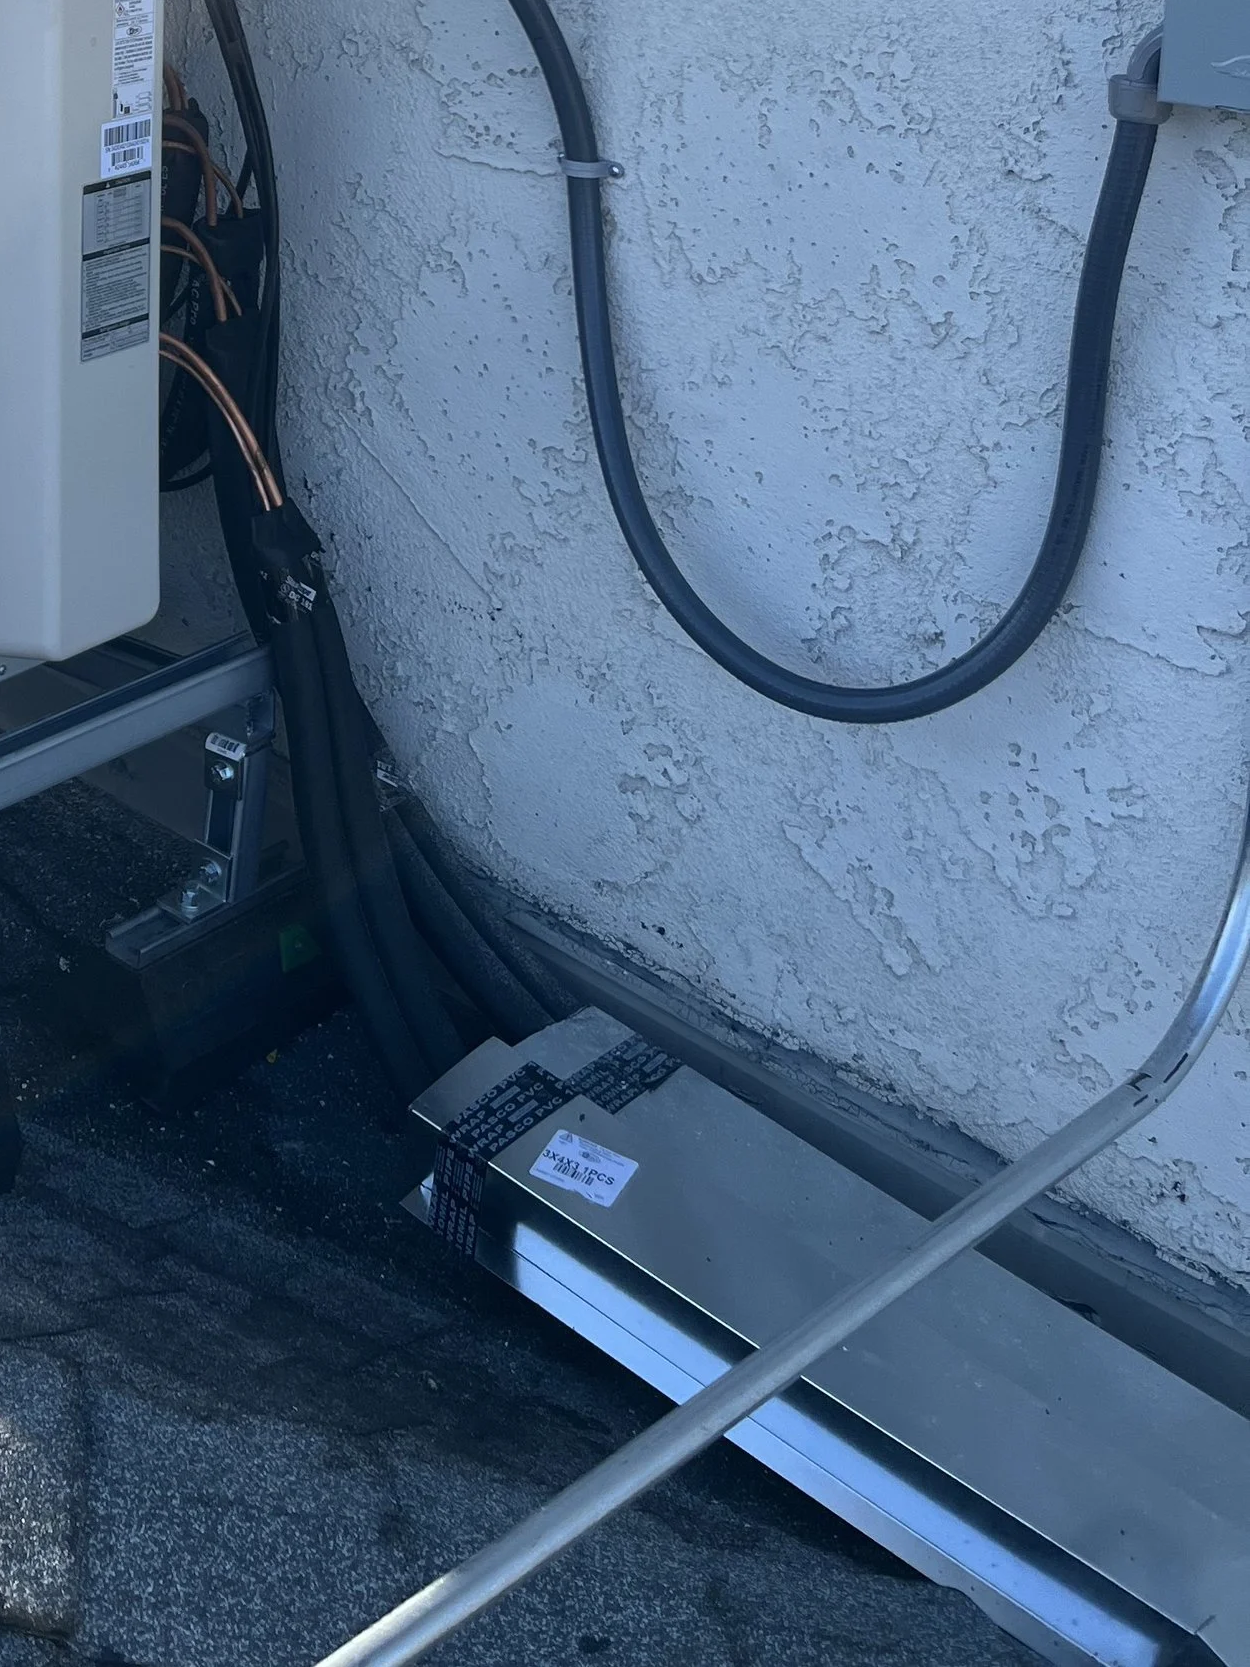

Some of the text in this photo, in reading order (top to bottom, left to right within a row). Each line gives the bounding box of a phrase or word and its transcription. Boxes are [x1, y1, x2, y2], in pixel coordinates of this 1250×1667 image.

[189, 300, 199, 326] Pro
[453, 1068, 526, 1125] PASCO PVC
[471, 1082, 544, 1138] PASCO PVC
[449, 1110, 486, 1143] WRAP
[467, 1123, 504, 1158] WRAP
[489, 1096, 562, 1152] PASCO PVC
[543, 1149, 580, 1171] 3X4X3
[583, 1166, 616, 1186] 1PCS
